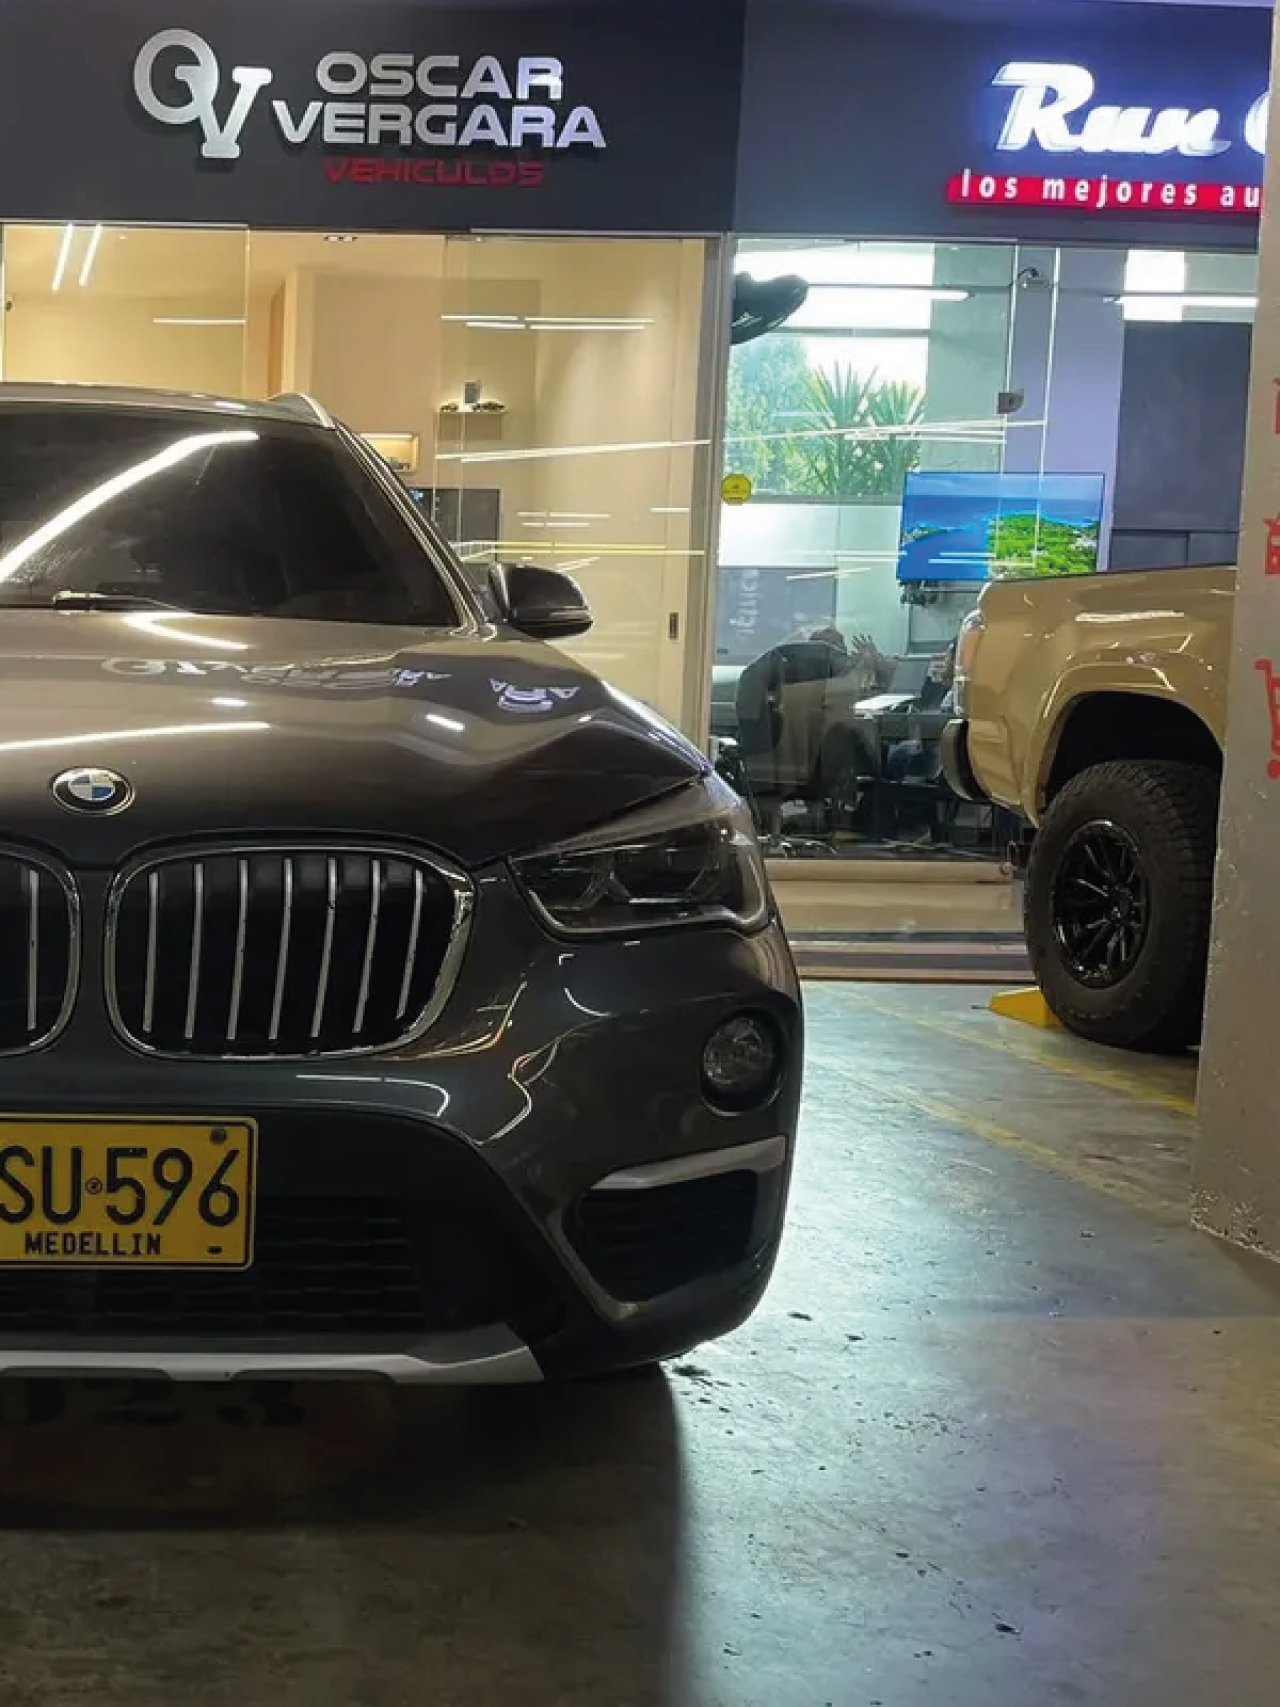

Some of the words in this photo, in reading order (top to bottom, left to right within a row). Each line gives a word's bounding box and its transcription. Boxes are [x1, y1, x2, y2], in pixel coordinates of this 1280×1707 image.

[316, 51, 564, 99] OSCAR
[272, 100, 607, 148] VERGARA
[991, 61, 1232, 156] Run
[324, 157, 546, 188] VEHICULOS
[961, 168, 1019, 199] los
[1042, 174, 1198, 209] mejores
[24, 1231, 162, 1256] MEDELLIN
